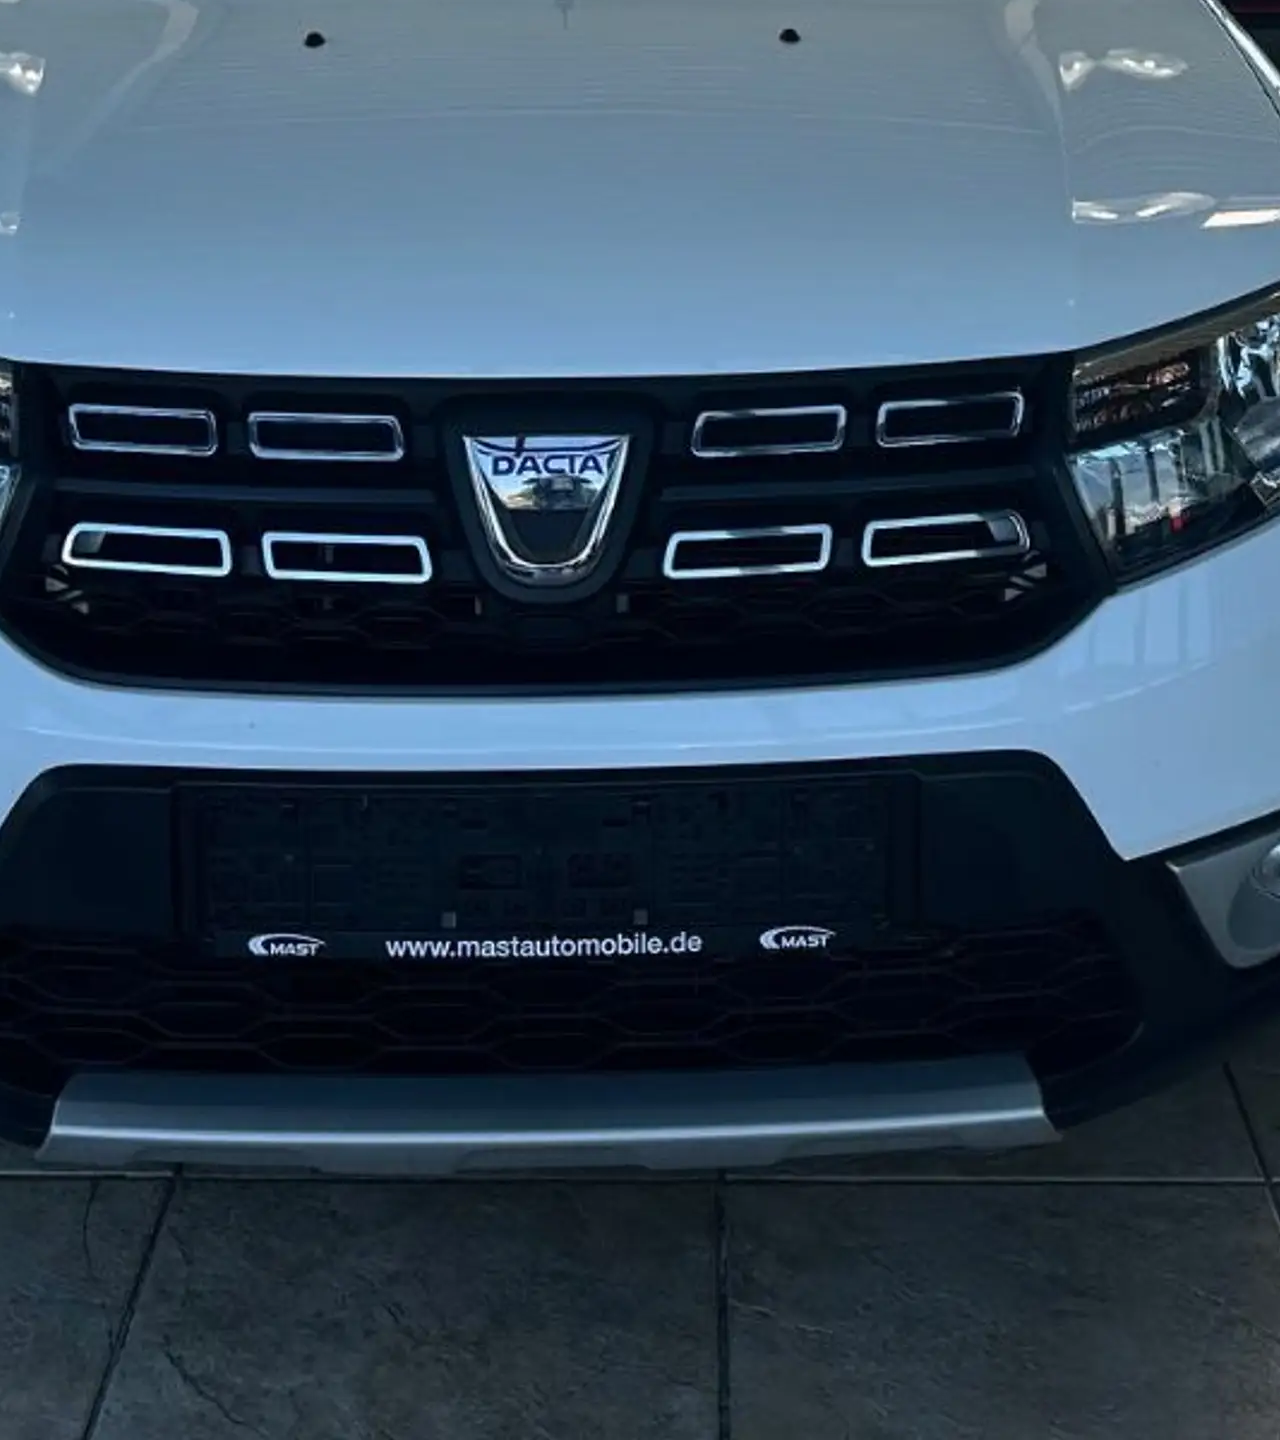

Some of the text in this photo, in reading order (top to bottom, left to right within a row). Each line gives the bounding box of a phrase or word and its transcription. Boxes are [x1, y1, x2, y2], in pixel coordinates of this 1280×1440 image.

[491, 454, 604, 477] DACIA
[269, 931, 830, 960] MAST www.mastautomobile.de MAST
